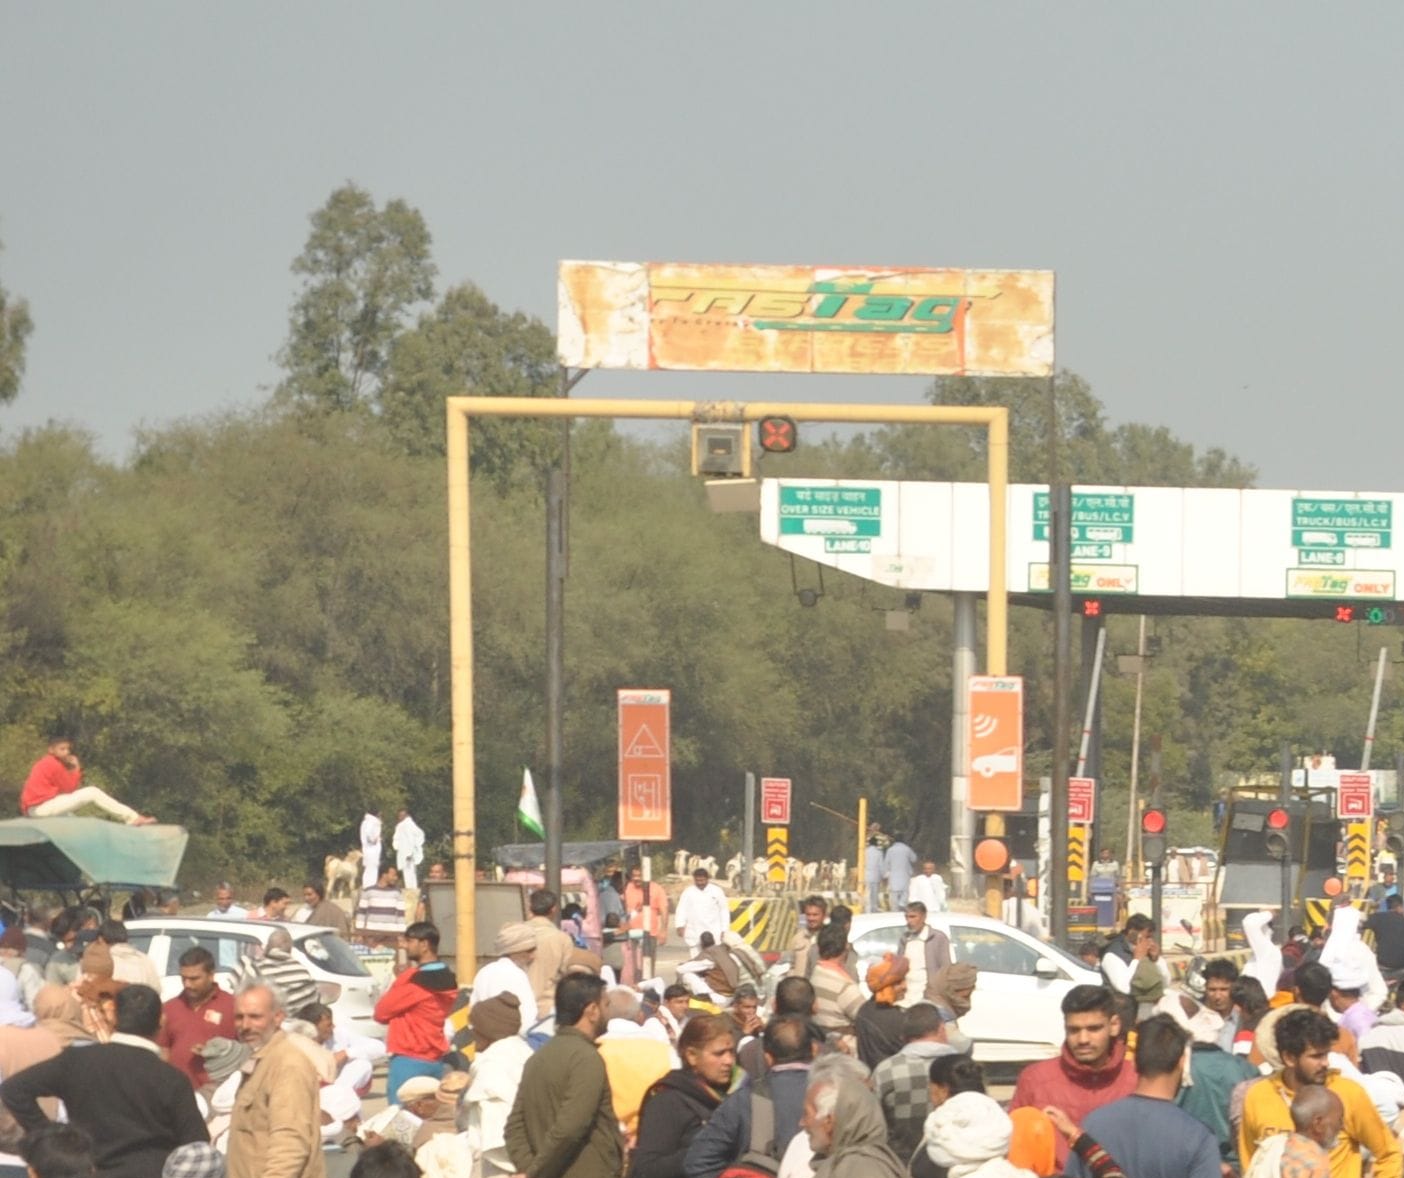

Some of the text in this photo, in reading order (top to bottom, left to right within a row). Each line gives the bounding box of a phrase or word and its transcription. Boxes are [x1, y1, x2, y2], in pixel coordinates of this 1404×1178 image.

[781, 504, 880, 517] OVER SIZE VEHICLE
[1070, 545, 1111, 557] ANE-9
[1353, 583, 1391, 594] ONLY
